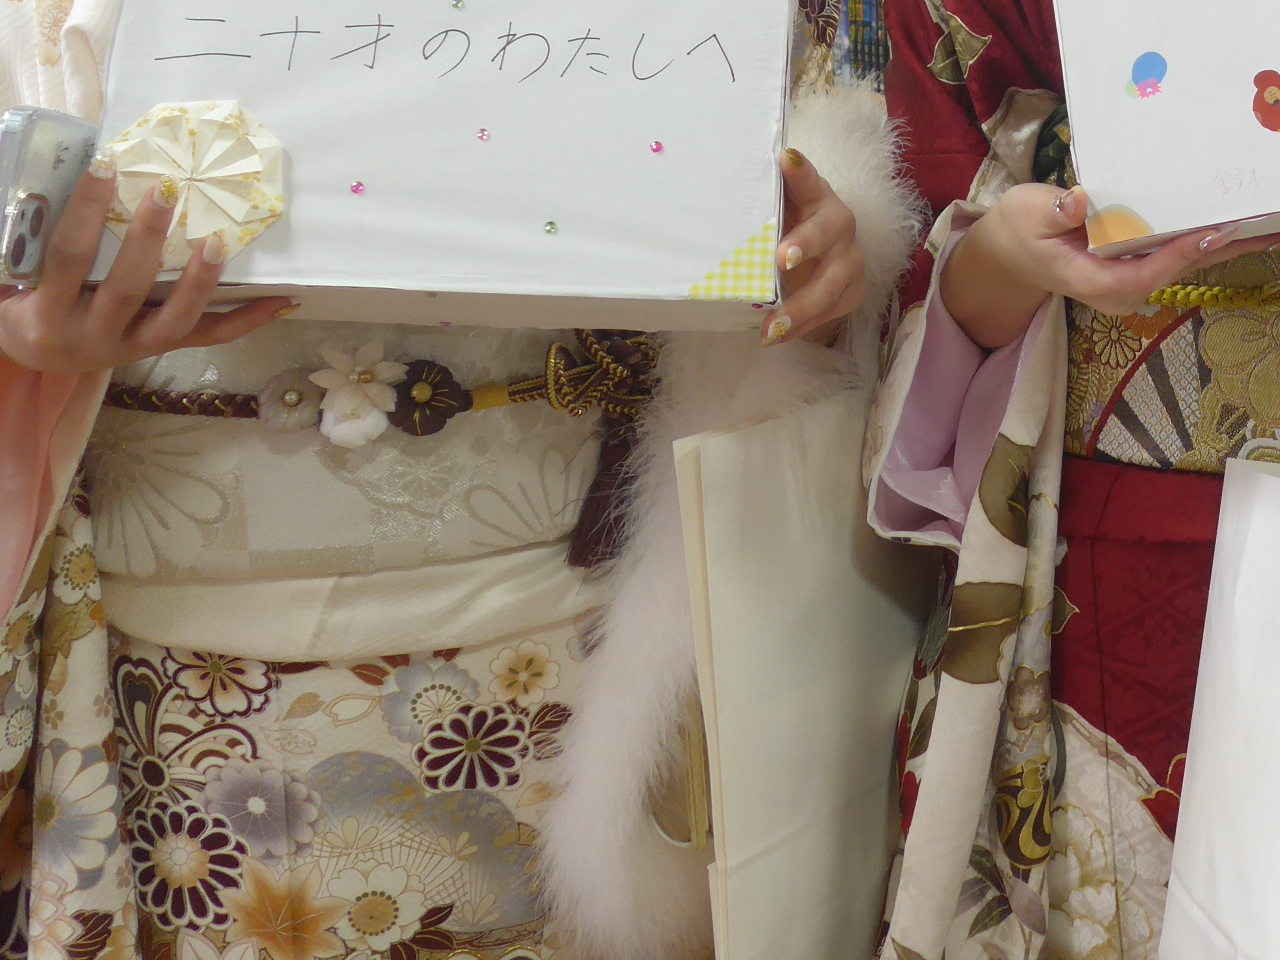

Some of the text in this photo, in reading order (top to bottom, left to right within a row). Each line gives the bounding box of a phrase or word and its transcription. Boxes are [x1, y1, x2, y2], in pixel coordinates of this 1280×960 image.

[154, 13, 738, 83] 二十才のわたしへ
